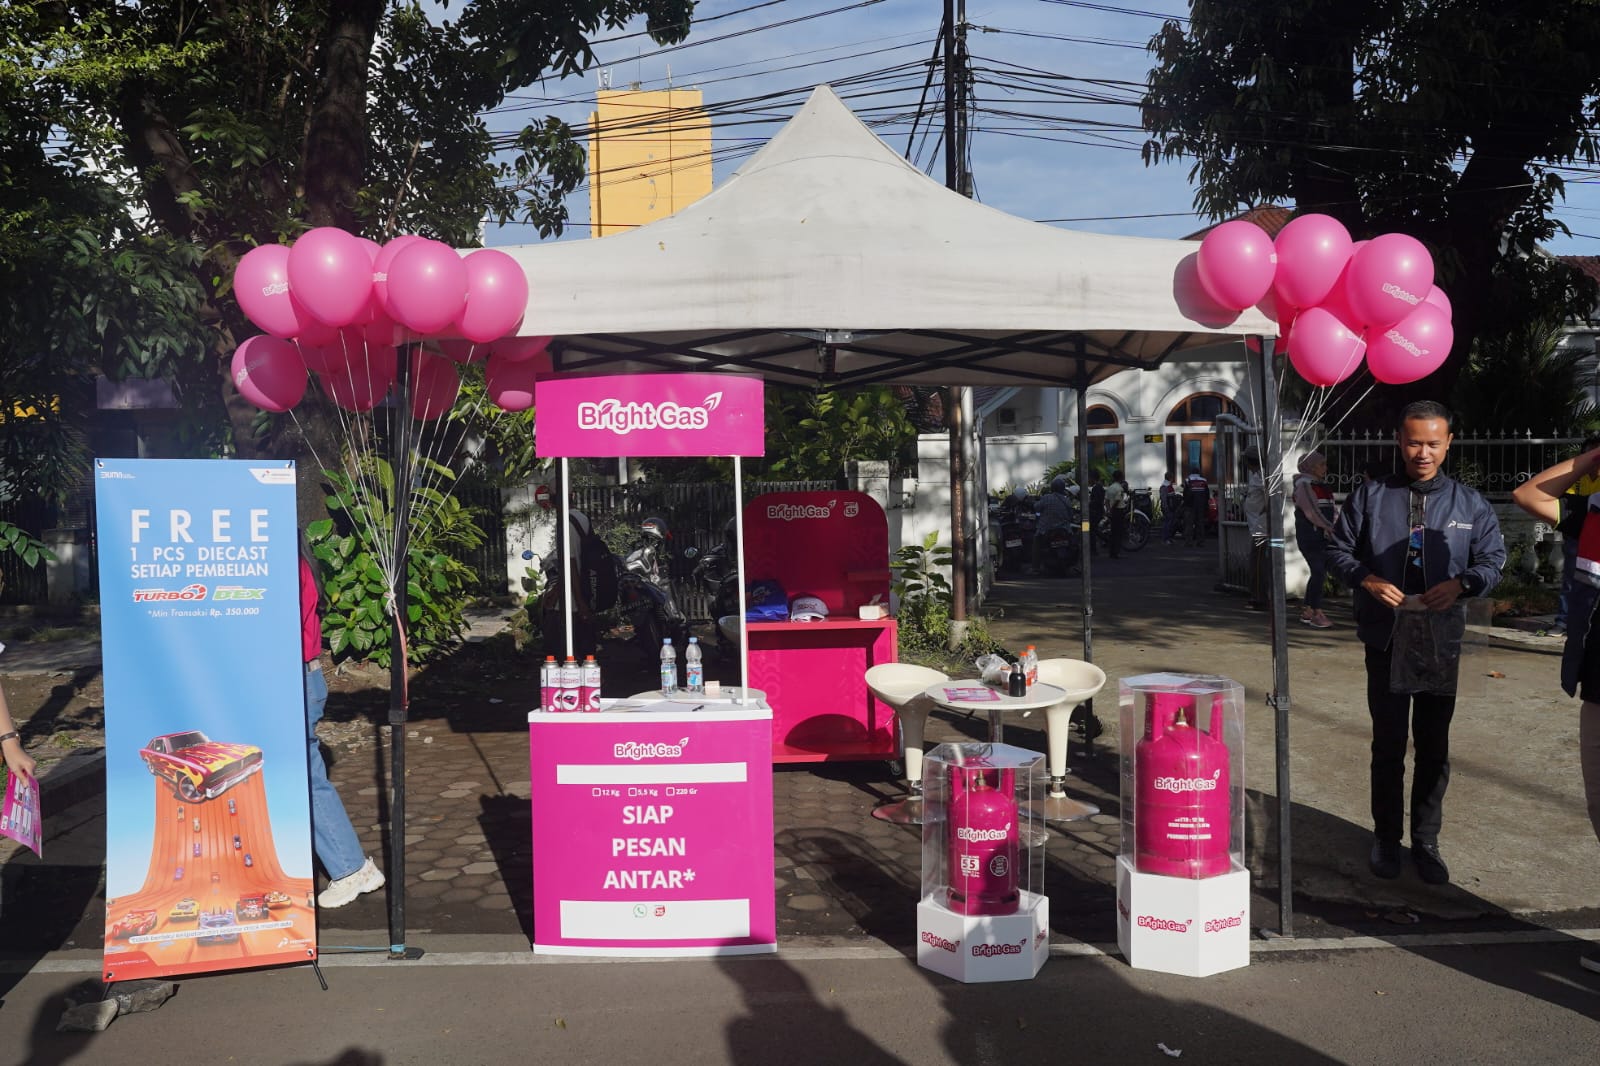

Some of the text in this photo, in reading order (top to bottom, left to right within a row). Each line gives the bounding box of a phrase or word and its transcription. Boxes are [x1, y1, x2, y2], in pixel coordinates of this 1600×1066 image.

[579, 400, 708, 433] Bright Gas
[768, 504, 830, 520] Bright Gas
[131, 509, 269, 543] FREE
[130, 546, 268, 562] 1 PCS DIECAST
[131, 563, 269, 579] SETIAP PEMBELIAN
[134, 589, 266, 602] TURBO DEX
[171, 609, 207, 617] Transaksi
[210, 608, 223, 618] Rp.
[614, 742, 682, 760] Bright Gas
[1154, 777, 1217, 791] Bright Gas
[611, 789, 620, 797] Kg
[649, 789, 658, 797] Kg
[622, 805, 674, 824] SIAP
[958, 827, 1007, 842] Bright Gas
[612, 838, 686, 857] PESAN
[1138, 916, 1187, 932] Bright Gas
[1205, 917, 1241, 932] Bright Gas
[921, 931, 956, 953] Bright Gas
[972, 944, 1021, 957] Bright Gas
